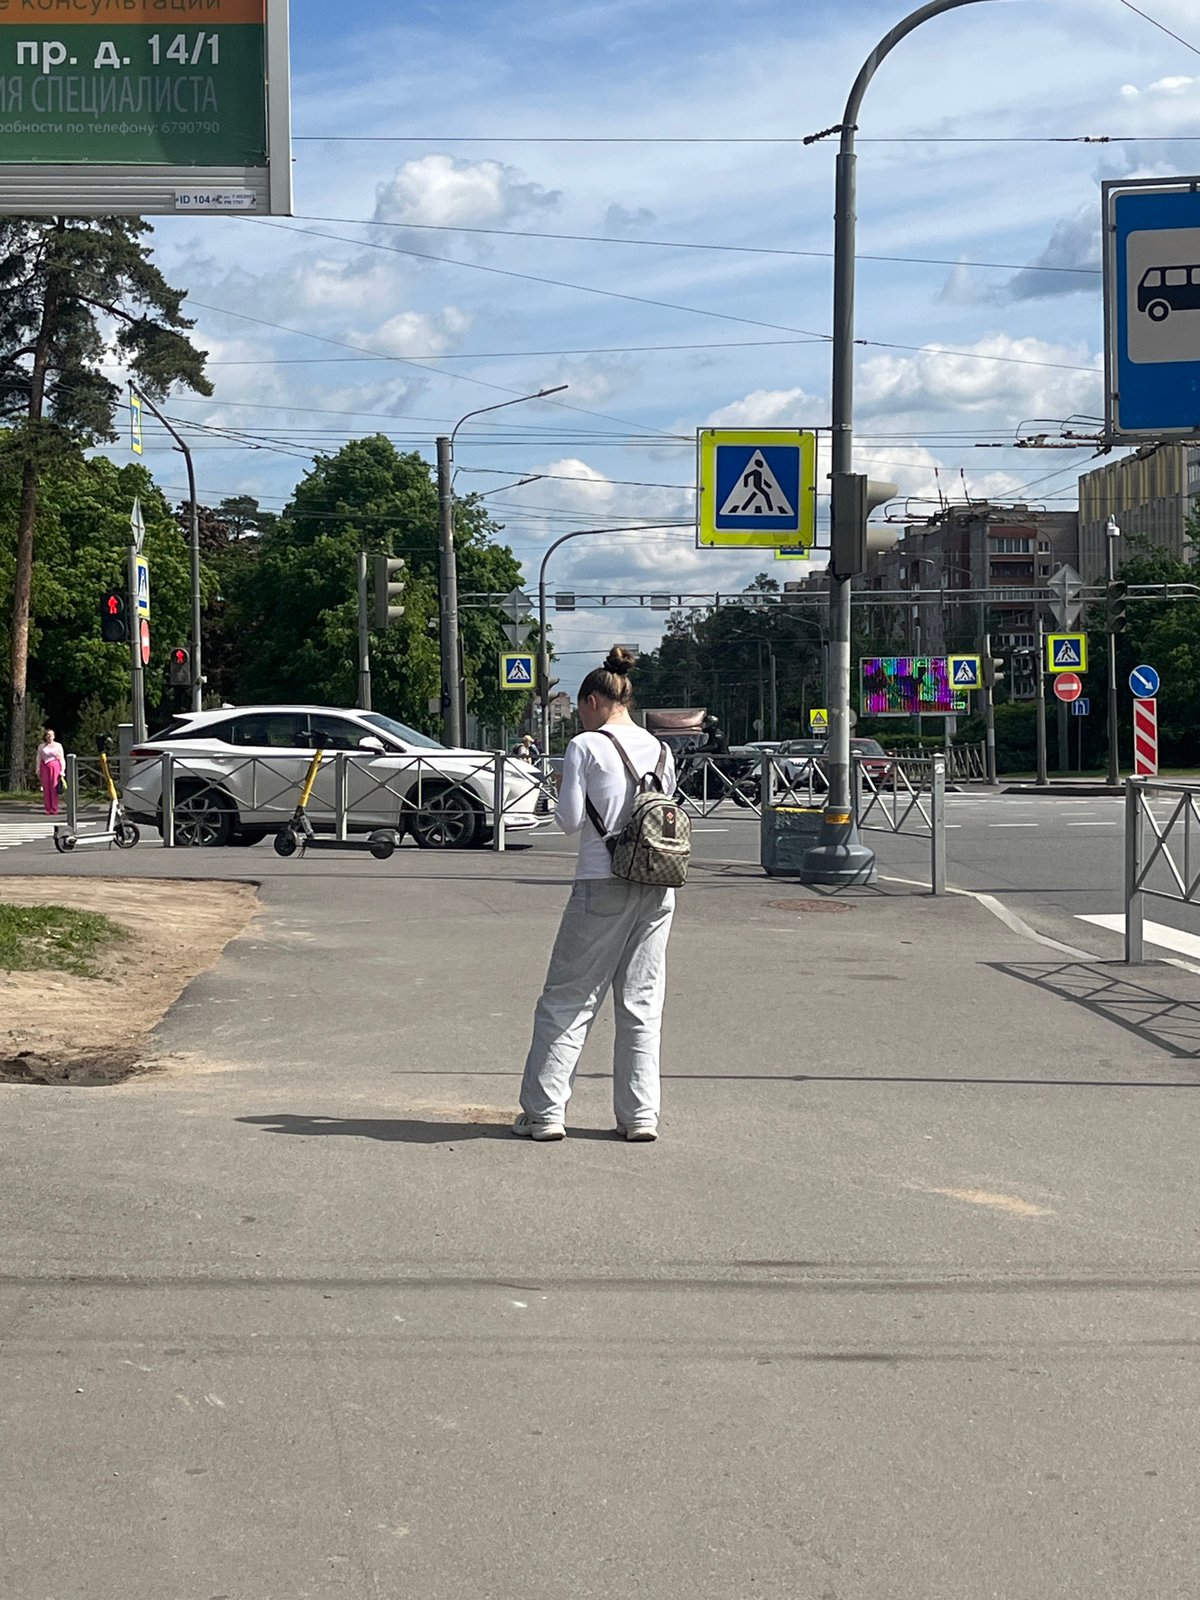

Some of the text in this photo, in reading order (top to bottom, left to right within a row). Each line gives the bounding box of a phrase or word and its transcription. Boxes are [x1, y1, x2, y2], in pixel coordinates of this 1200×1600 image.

[16, 31, 219, 74] пр. д. 14/1
[31, 75, 218, 119] СПЕЦИАЛИСТА
[66, 123, 84, 133] по
[88, 121, 158, 136] телефону:
[161, 121, 220, 134] 6790790
[179, 195, 191, 205] ID
[193, 195, 211, 205] 104
